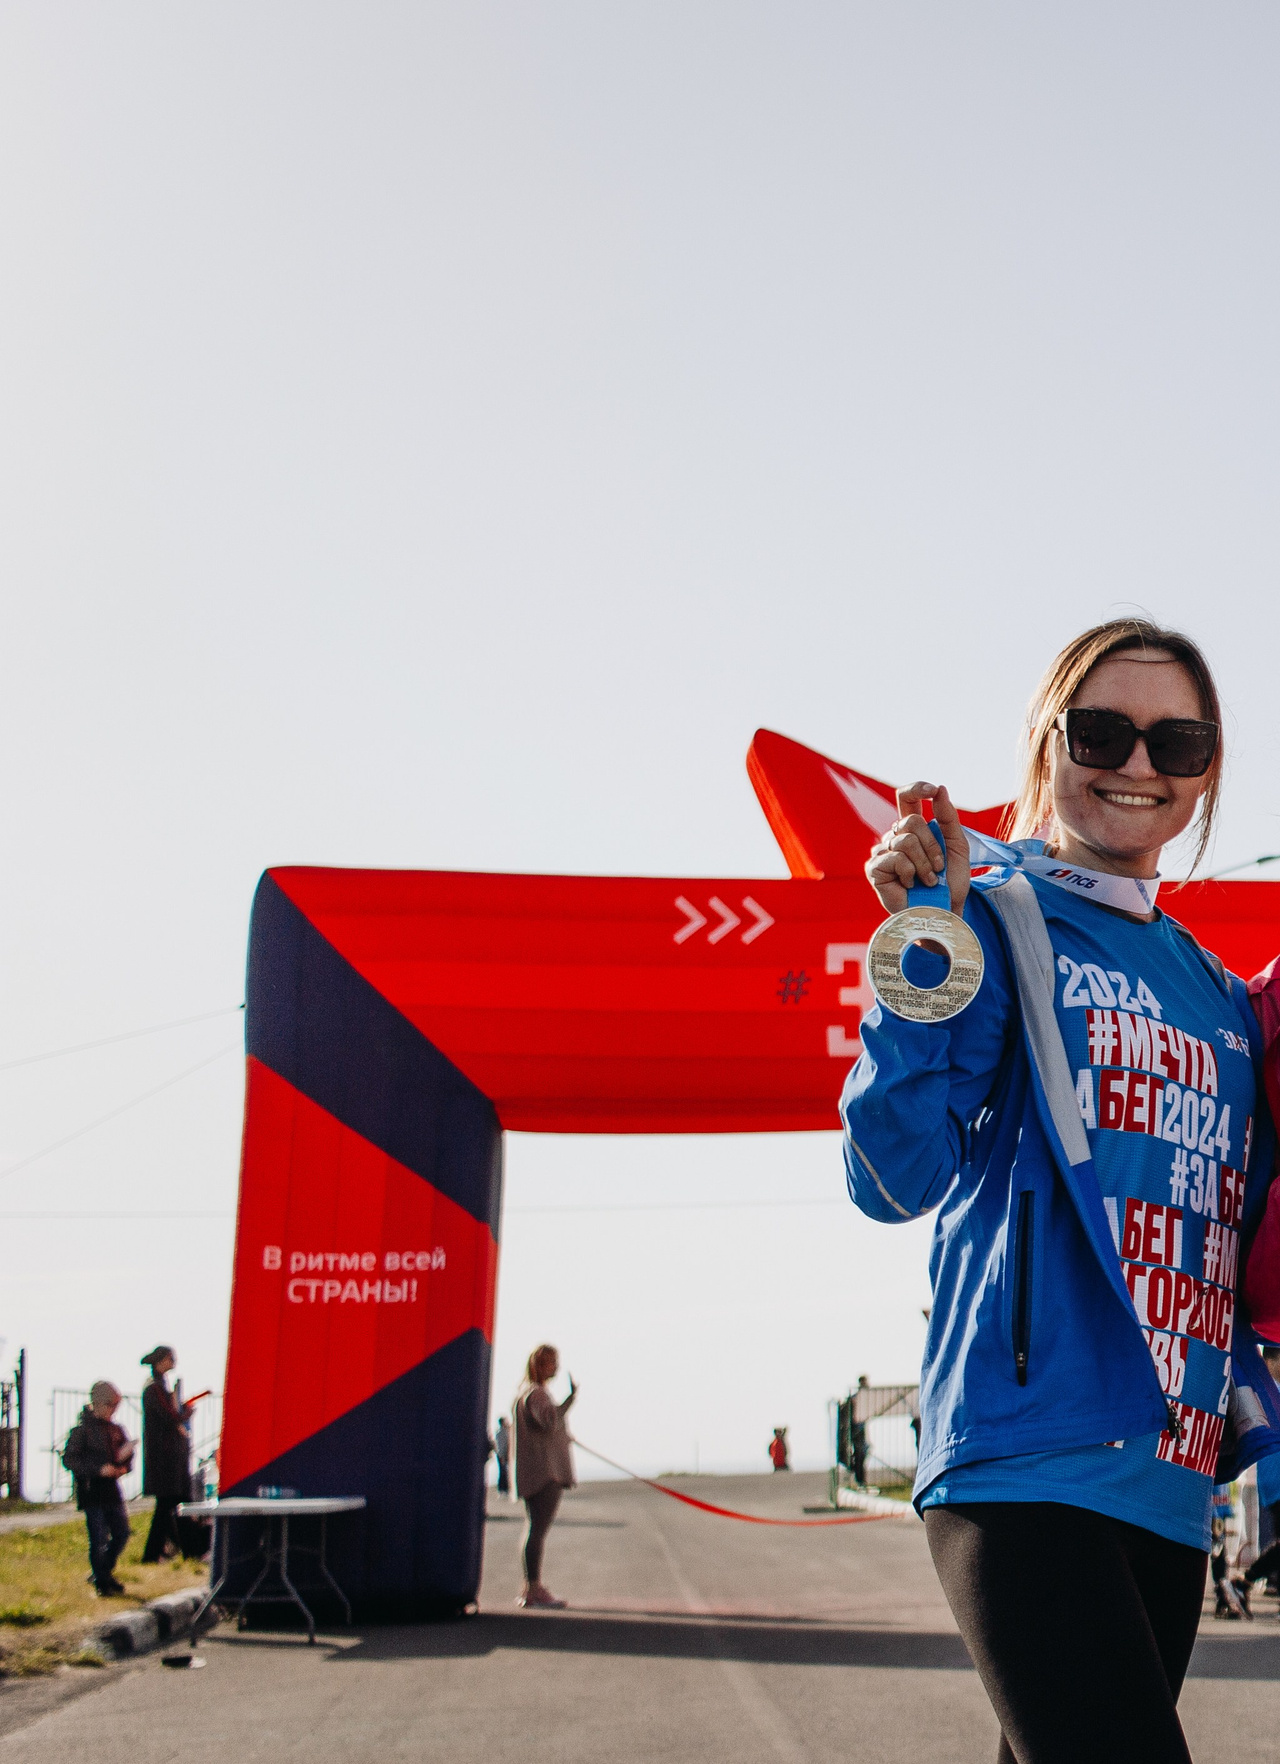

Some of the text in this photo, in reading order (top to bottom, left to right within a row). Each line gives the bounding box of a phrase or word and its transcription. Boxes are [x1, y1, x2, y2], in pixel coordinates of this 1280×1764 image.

[1066, 874, 1099, 889] ПСБ
[1058, 955, 1163, 1019] 2024
[1088, 1009, 1218, 1097] #МЕЧТА
[263, 1245, 447, 1274] В ритме всей
[288, 1278, 418, 1303] СТРАНЫ!
